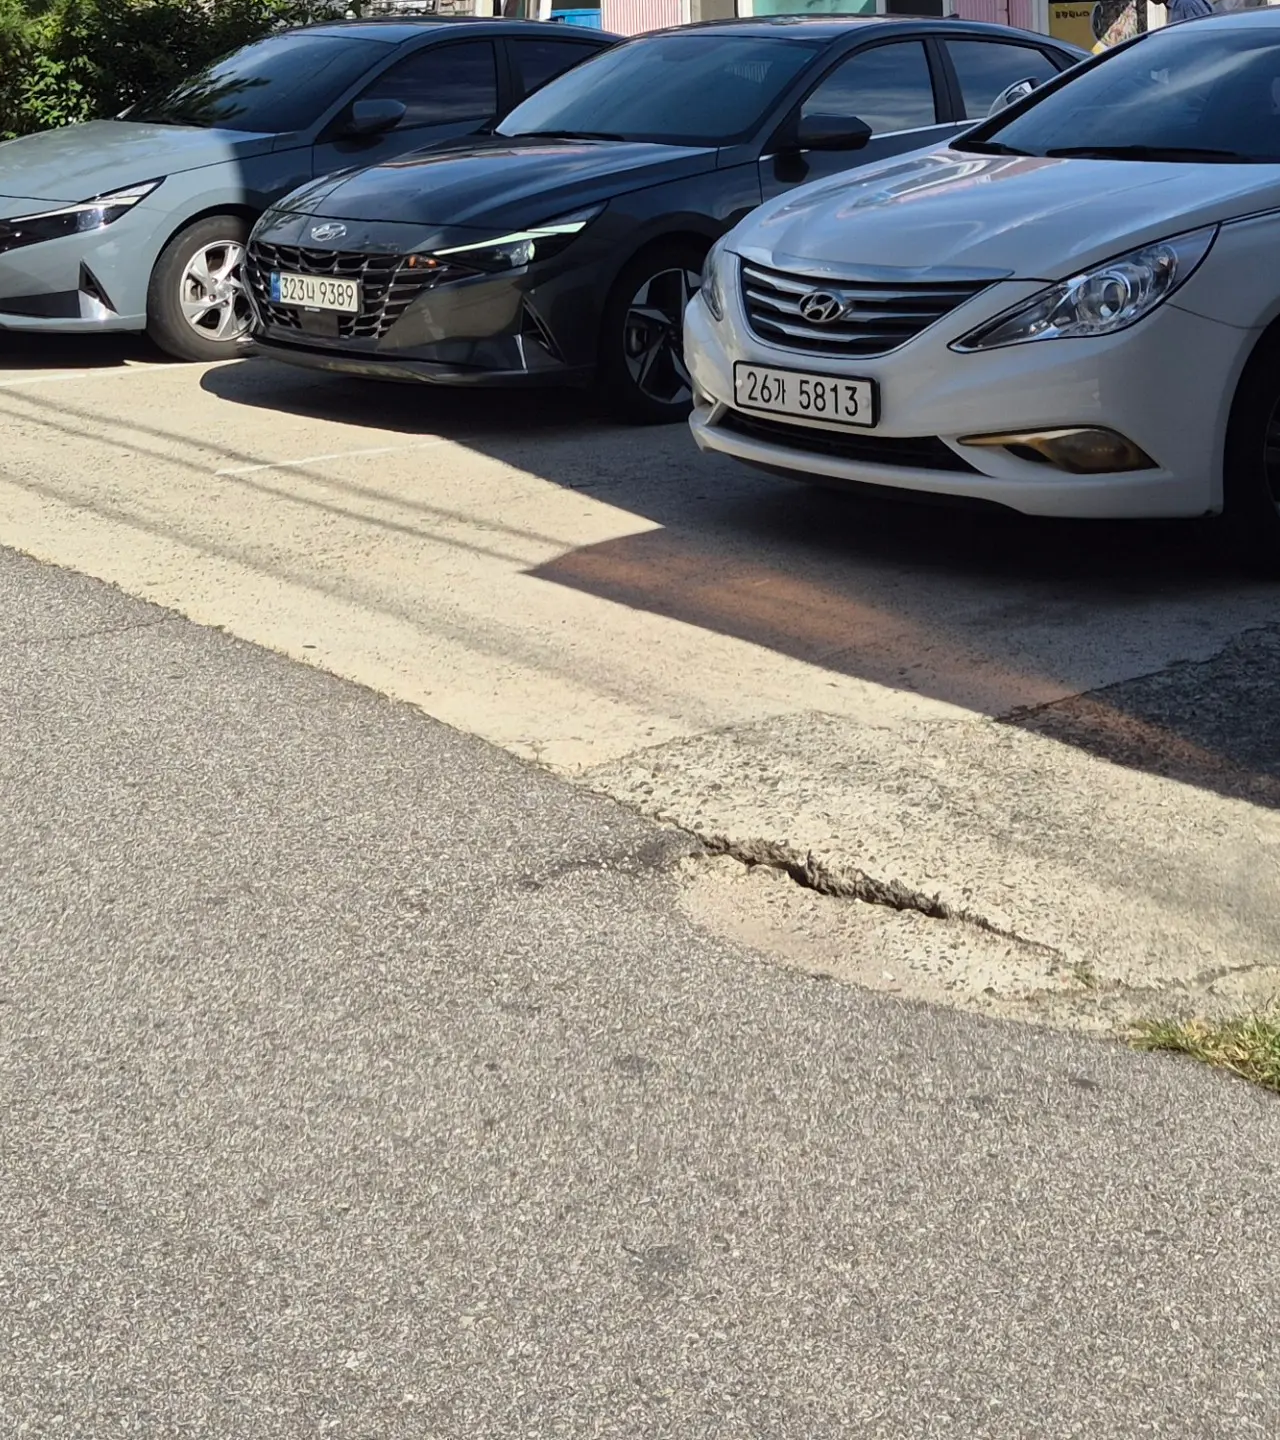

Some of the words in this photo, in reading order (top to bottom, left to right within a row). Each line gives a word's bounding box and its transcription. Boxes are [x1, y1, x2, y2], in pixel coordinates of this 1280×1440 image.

[319, 281, 354, 308] 9389
[747, 371, 787, 405] 26가
[798, 379, 859, 417] 5813
